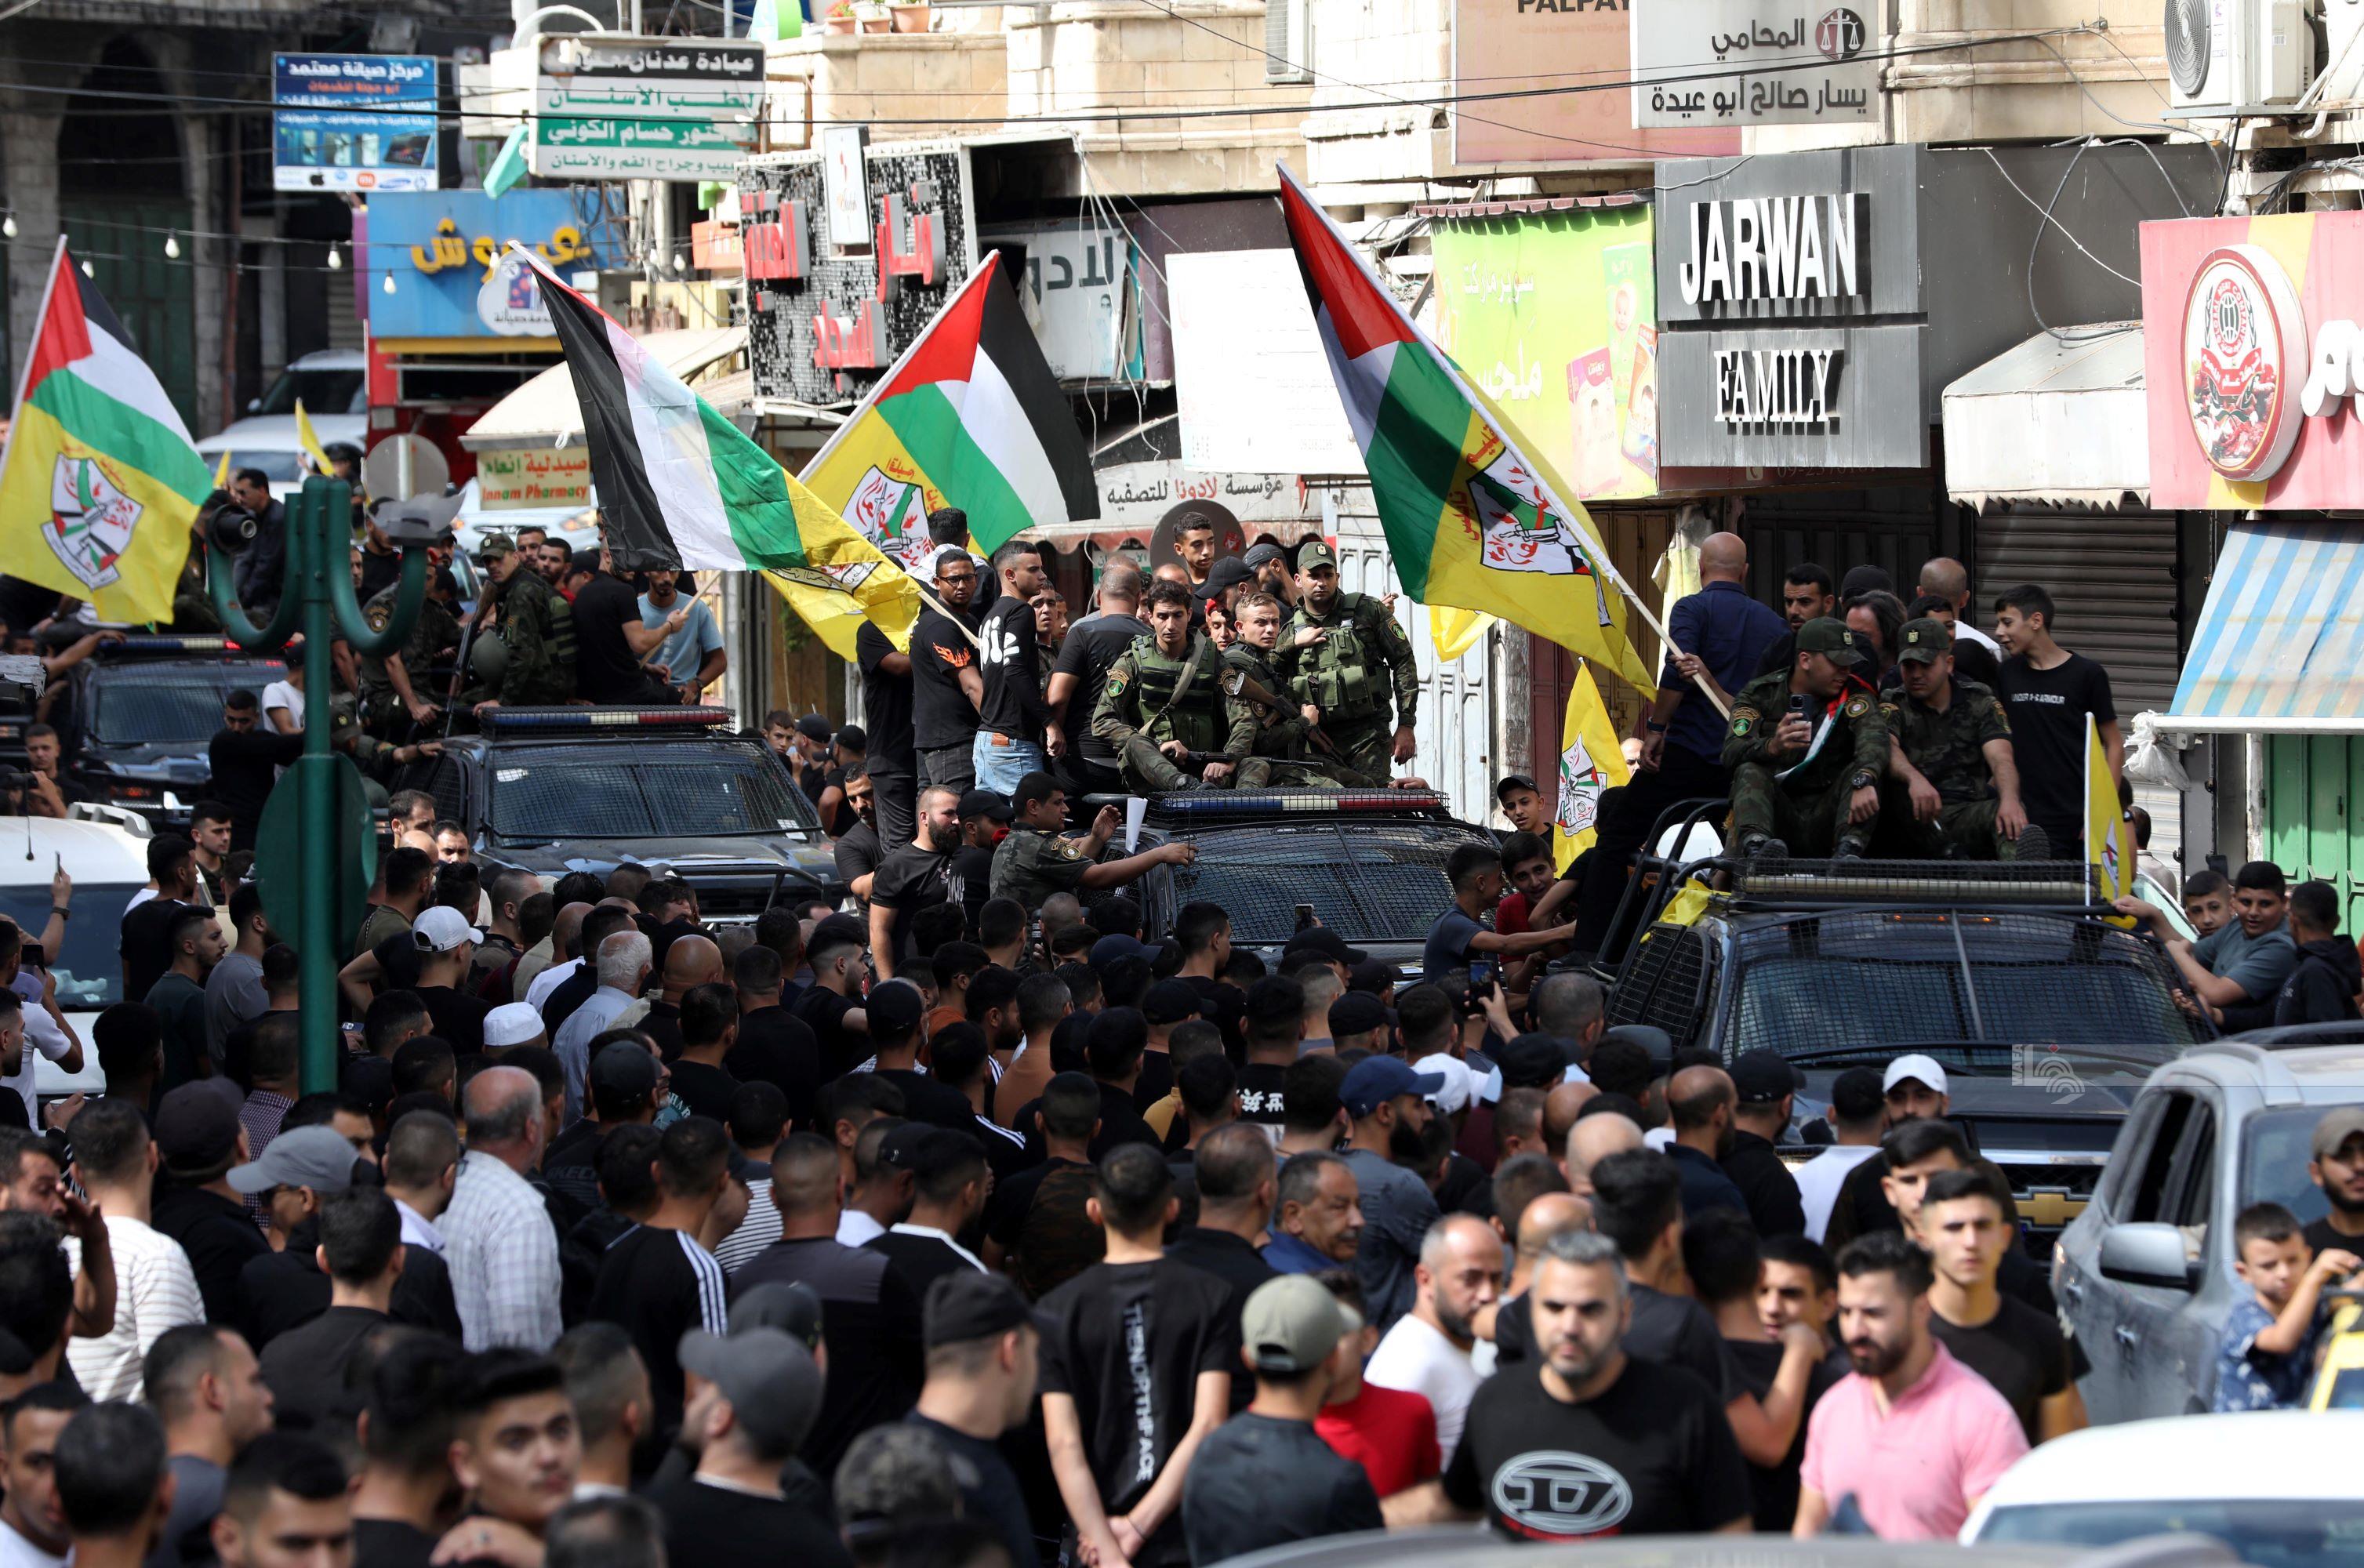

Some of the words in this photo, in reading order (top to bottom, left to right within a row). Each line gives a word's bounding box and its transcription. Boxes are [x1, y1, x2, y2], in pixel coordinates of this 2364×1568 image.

[1712, 18, 1805, 61] المحامي
[288, 60, 342, 77] معتمد
[342, 61, 387, 80] صيانة
[389, 62, 424, 82] مركز
[630, 50, 689, 73] عدنان
[695, 53, 754, 75] عيادة
[549, 84, 662, 108] الأسنان
[1652, 85, 1705, 118] عيدة
[1714, 74, 1745, 118] أبو
[1750, 80, 1810, 116] صالح
[1815, 79, 1867, 114] يسار
[547, 119, 615, 143] الكوني
[620, 122, 674, 147] حسام
[619, 155, 652, 170] الفم
[655, 156, 703, 172] وجراح
[1679, 193, 1858, 305] JARWAN
[1713, 349, 1834, 423] FAMILY
[484, 453, 521, 478] إنعام
[525, 453, 587, 477] صيدلية
[482, 487, 521, 502] Innam
[525, 484, 587, 503] Pharmacy
[1107, 480, 1168, 512] للتصفيه
[1175, 476, 1218, 500] لادونا
[1226, 474, 1284, 499] مؤسسة
